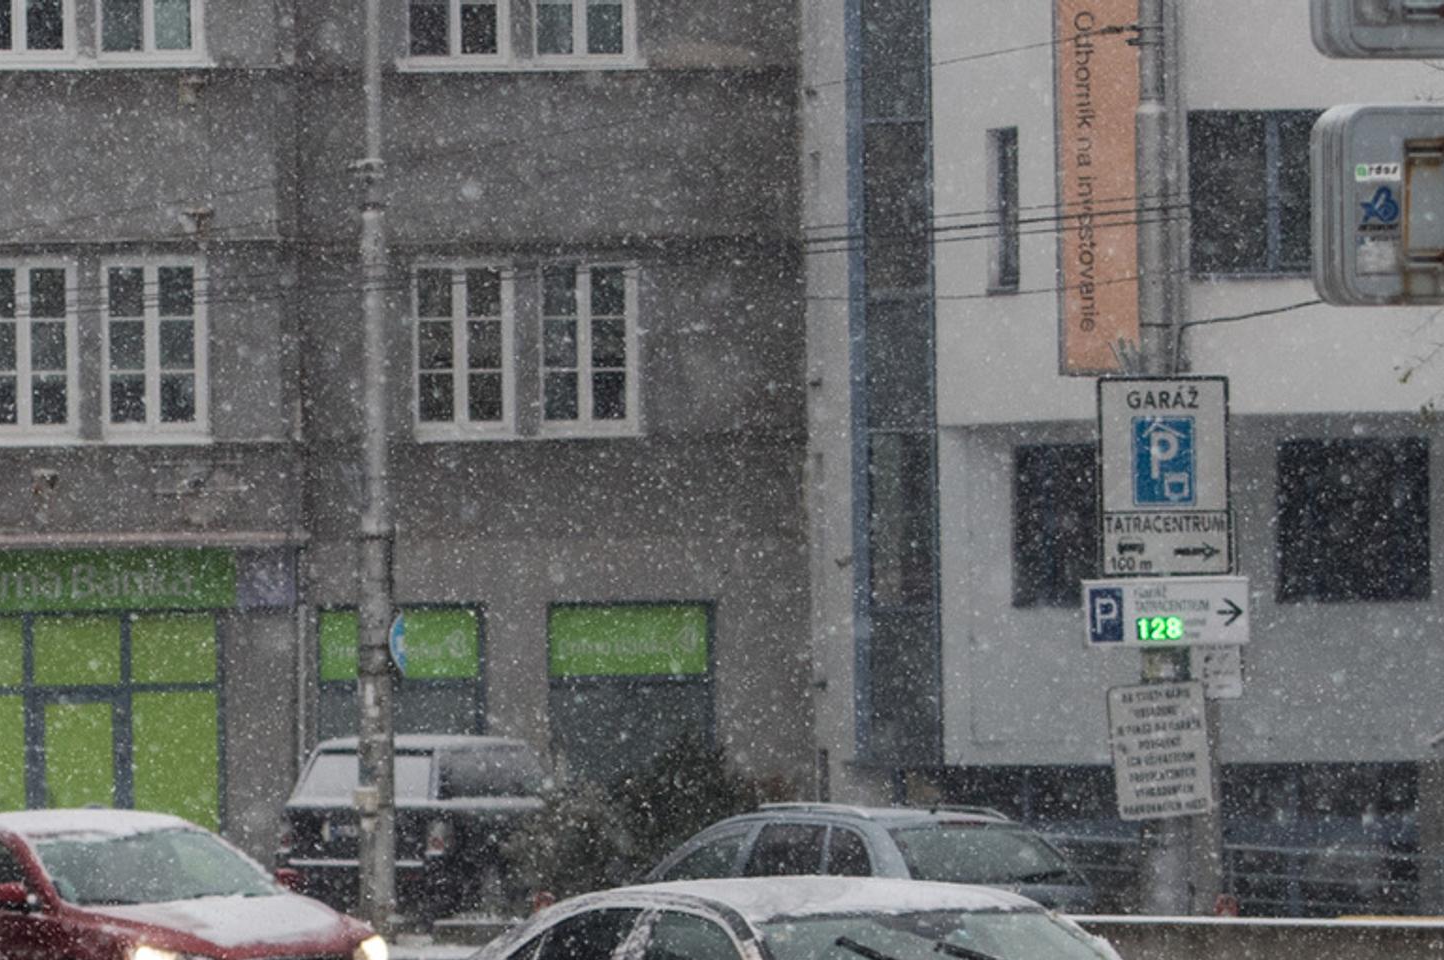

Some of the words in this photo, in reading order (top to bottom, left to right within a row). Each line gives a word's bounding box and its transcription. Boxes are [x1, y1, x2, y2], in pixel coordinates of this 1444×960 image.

[1077, 137, 1094, 167] na
[1078, 177, 1098, 332] investovanie
[1127, 385, 1199, 409] GARÁŽ
[1106, 515, 1227, 534] TATRACENTRUM
[1111, 557, 1136, 571] 100
[1140, 559, 1152, 571] m
[1137, 615, 1183, 640] 128
